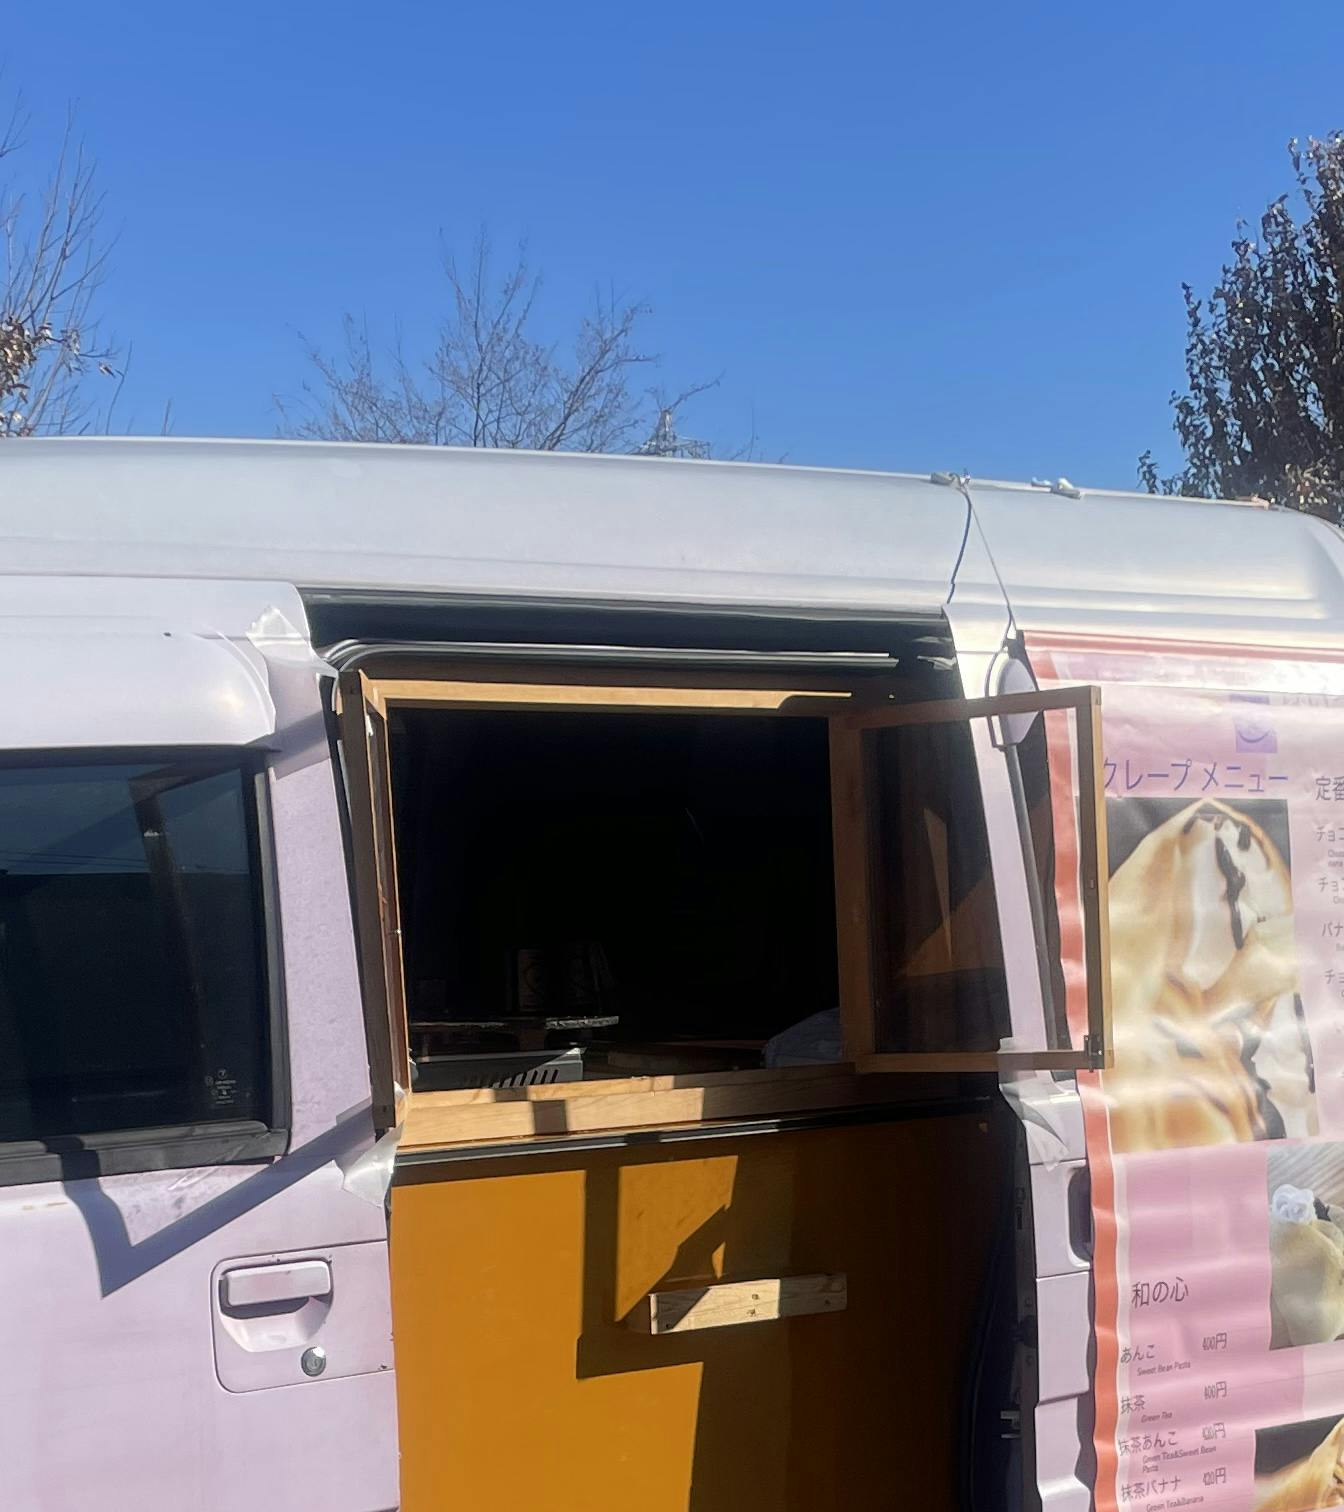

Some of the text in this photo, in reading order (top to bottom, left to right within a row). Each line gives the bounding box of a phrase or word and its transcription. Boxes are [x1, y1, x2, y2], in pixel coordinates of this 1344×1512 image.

[1103, 756, 1289, 792] クレープ メニュー
[1131, 1276, 1189, 1309] 和の心
[1120, 1344, 1155, 1364] あんこ
